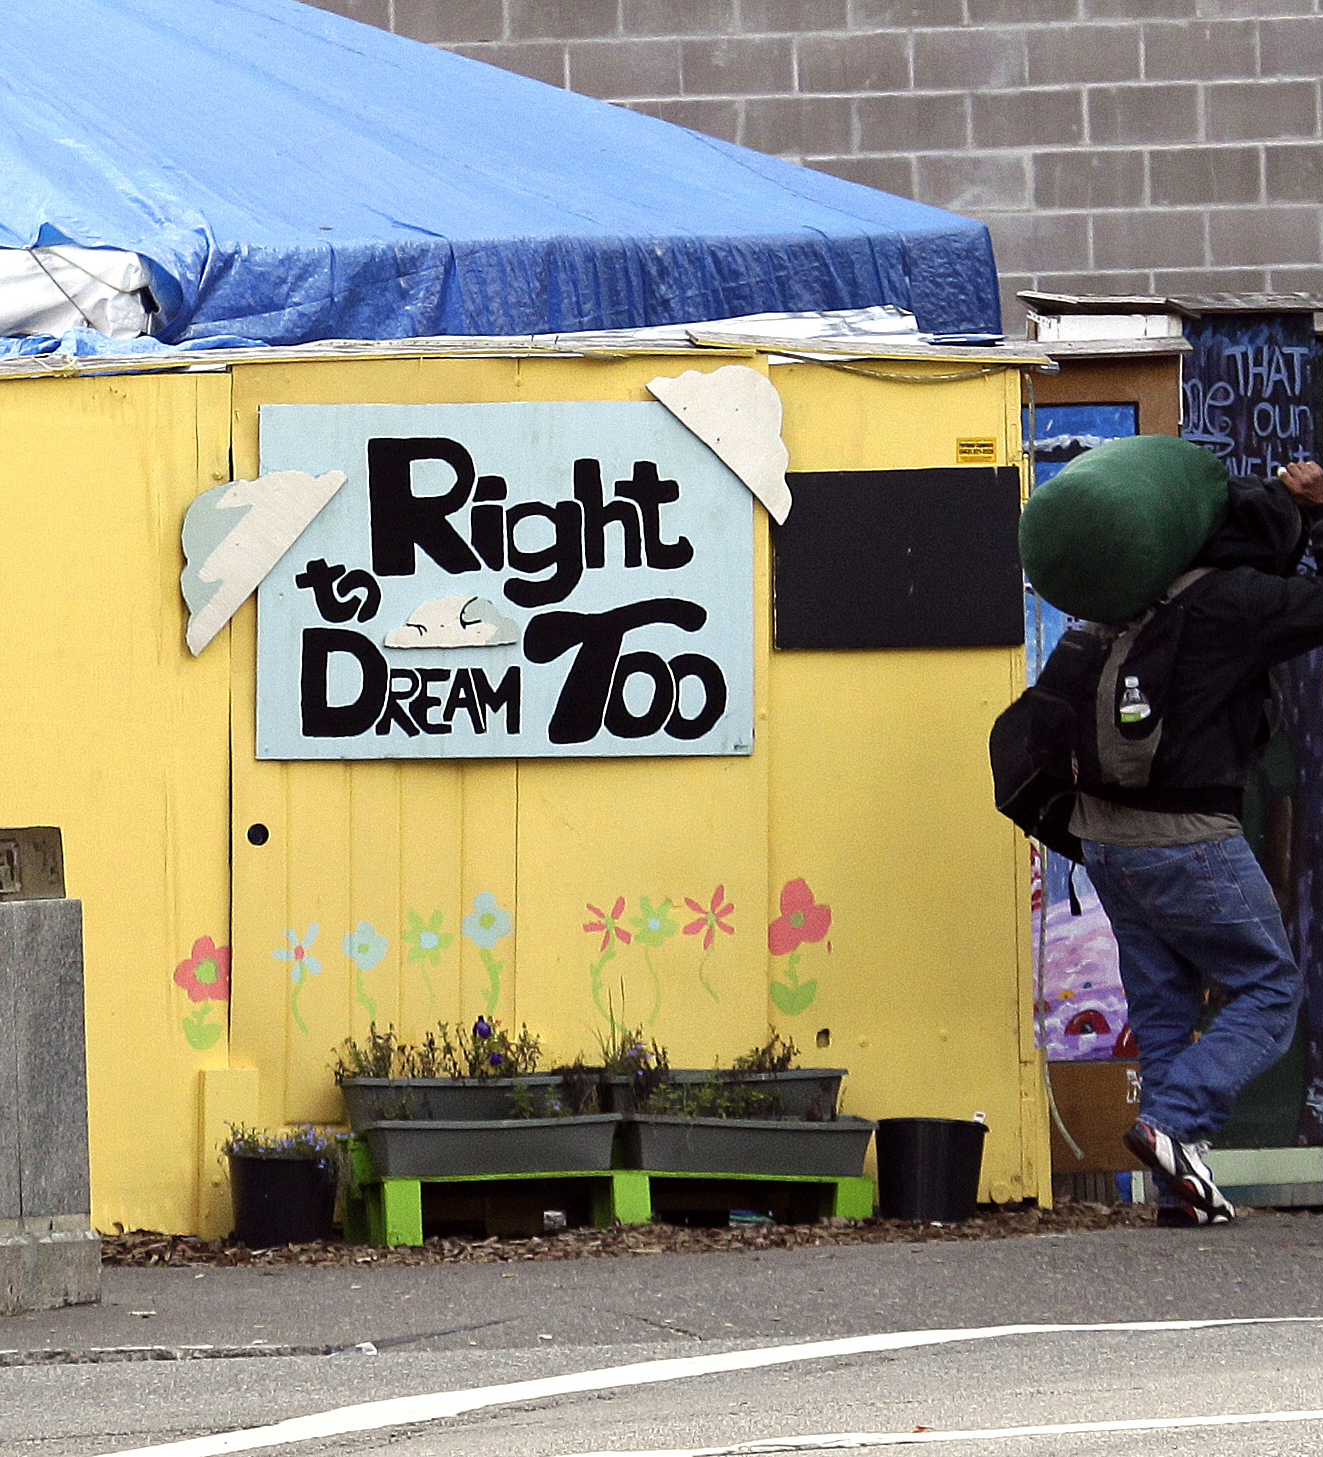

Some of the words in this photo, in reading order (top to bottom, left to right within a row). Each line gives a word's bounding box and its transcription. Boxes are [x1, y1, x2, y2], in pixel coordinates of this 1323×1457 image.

[1223, 345, 1310, 398] THAT
[367, 437, 694, 606] Right
[294, 557, 382, 624] to
